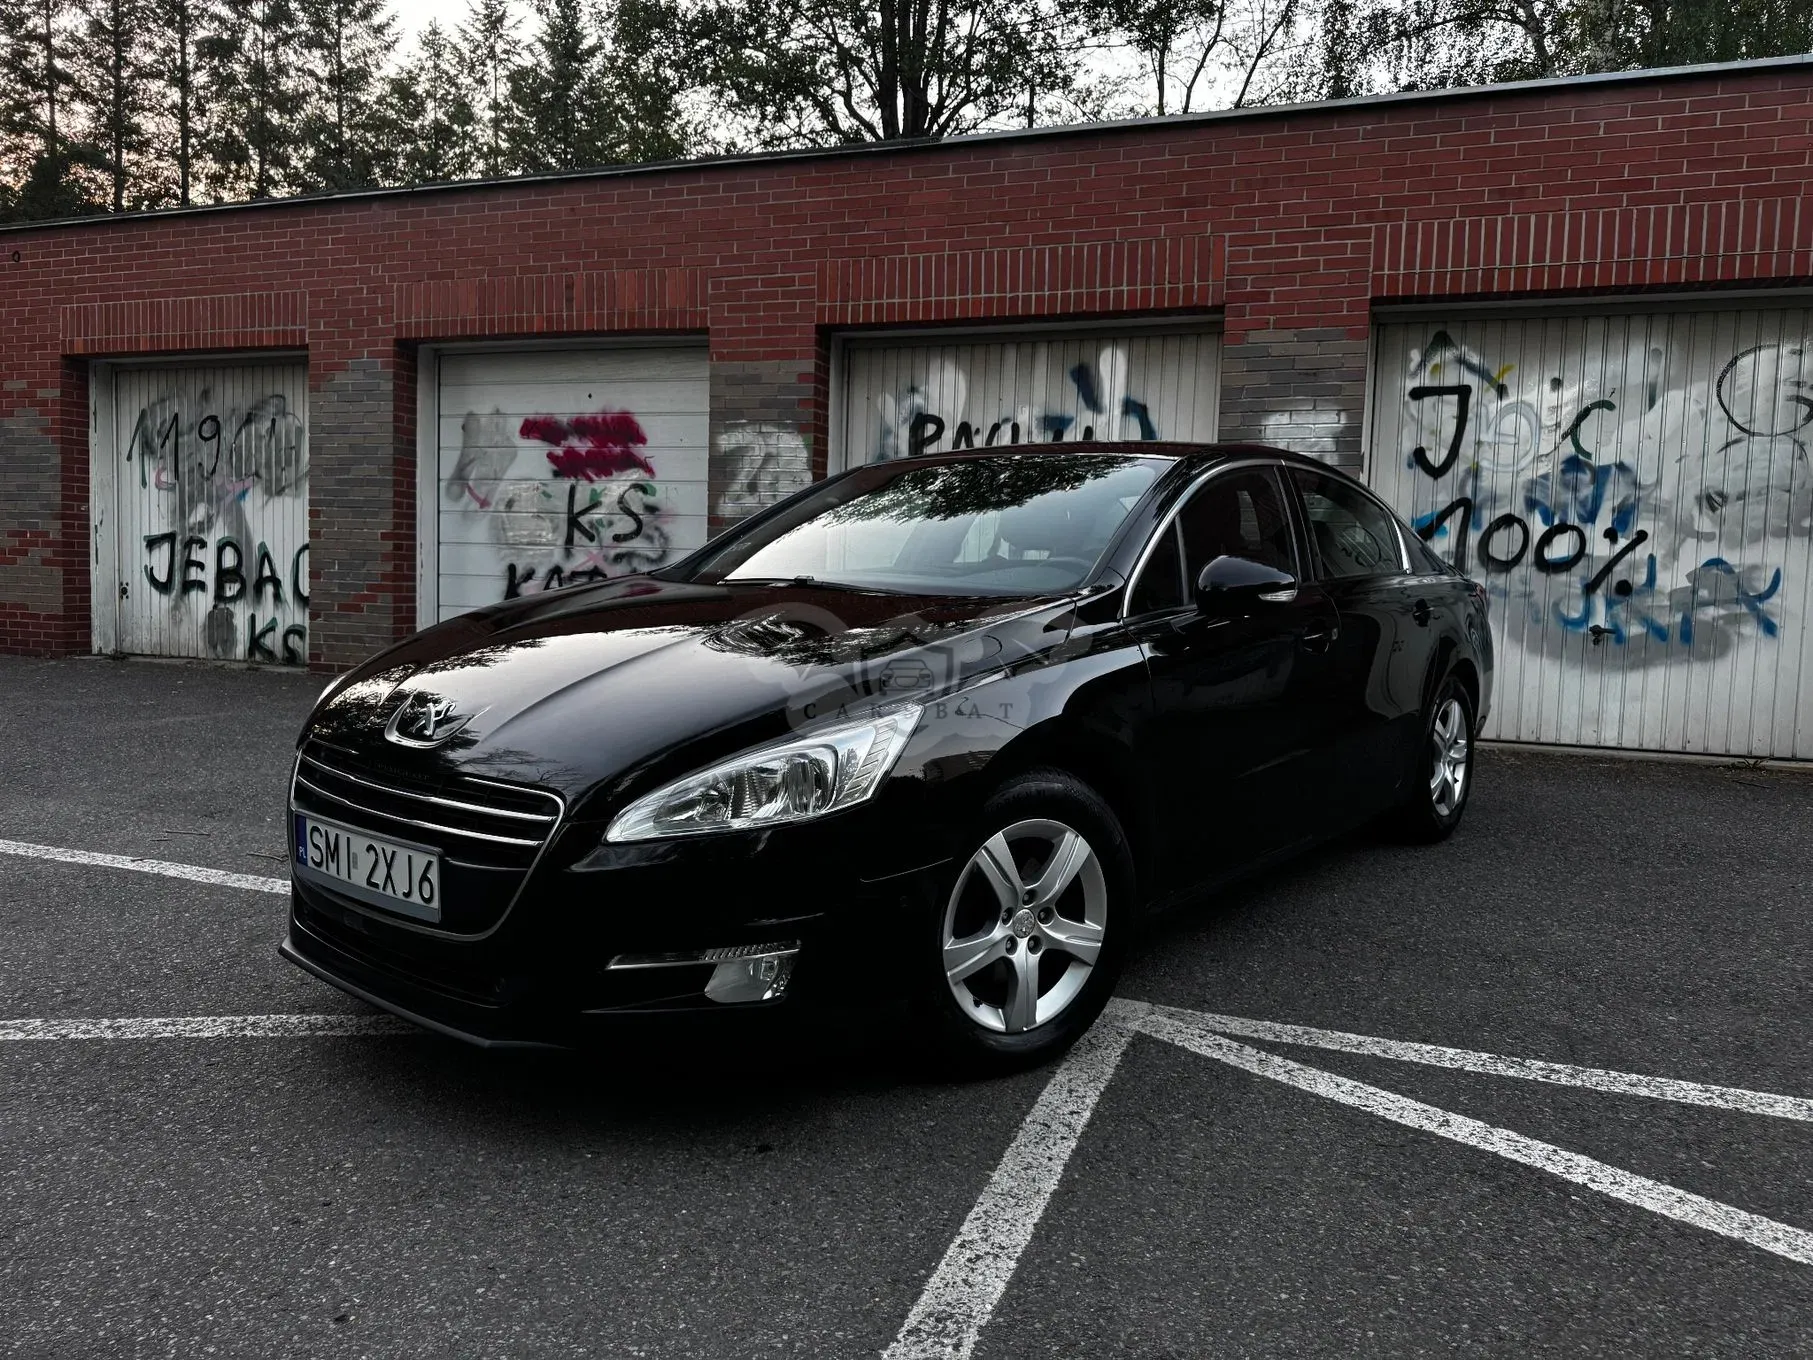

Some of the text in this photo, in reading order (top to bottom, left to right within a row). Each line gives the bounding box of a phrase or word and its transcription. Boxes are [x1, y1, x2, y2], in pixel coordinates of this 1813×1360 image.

[562, 482, 651, 560] KS
[1414, 497, 1649, 596] 100%
[248, 612, 307, 665] KS
[309, 825, 434, 904] SMI 2XJ6
